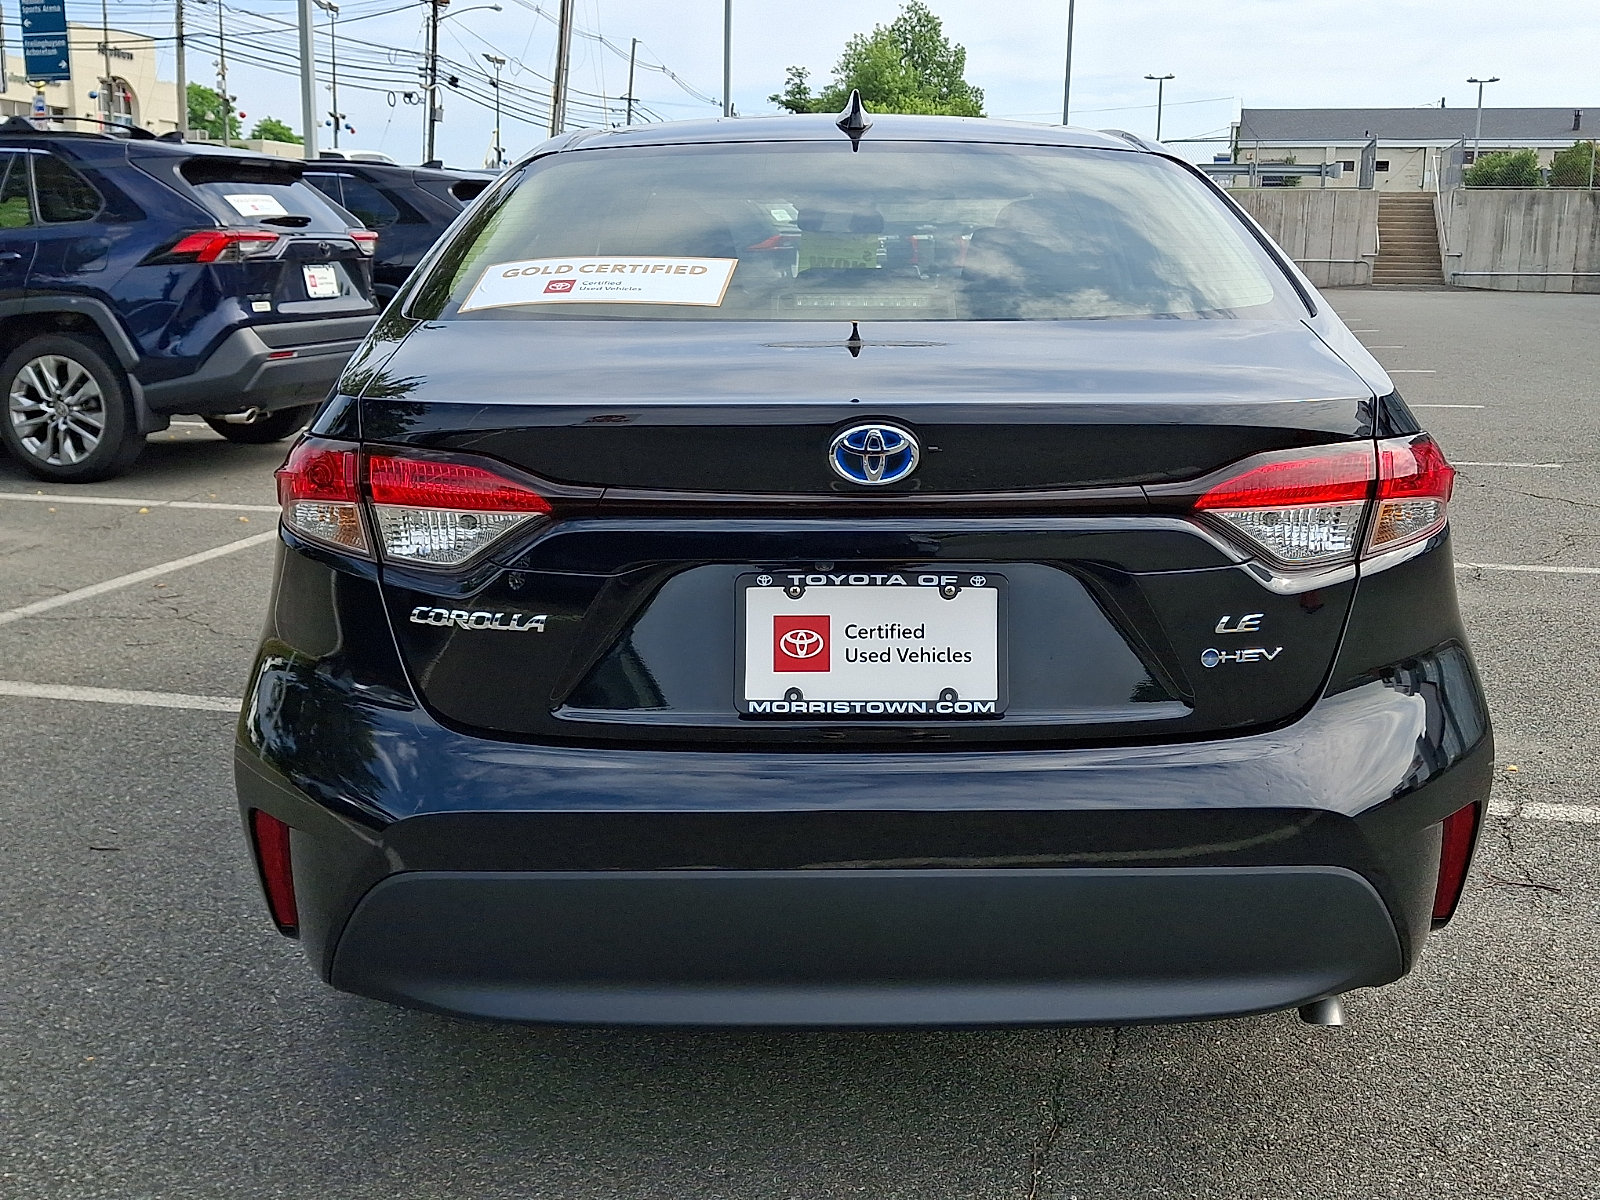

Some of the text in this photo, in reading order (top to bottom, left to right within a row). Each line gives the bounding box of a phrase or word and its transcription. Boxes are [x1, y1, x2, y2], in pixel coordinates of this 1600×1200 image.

[502, 264, 708, 278] GOLD CERTIFIED
[787, 574, 959, 586] TOYOTA OF
[409, 606, 548, 633] COROLLA
[1215, 613, 1265, 634] LE
[844, 623, 925, 640] Certified
[845, 647, 972, 663] Used Vehicles
[748, 701, 996, 714] MORRISTOWN.COM
